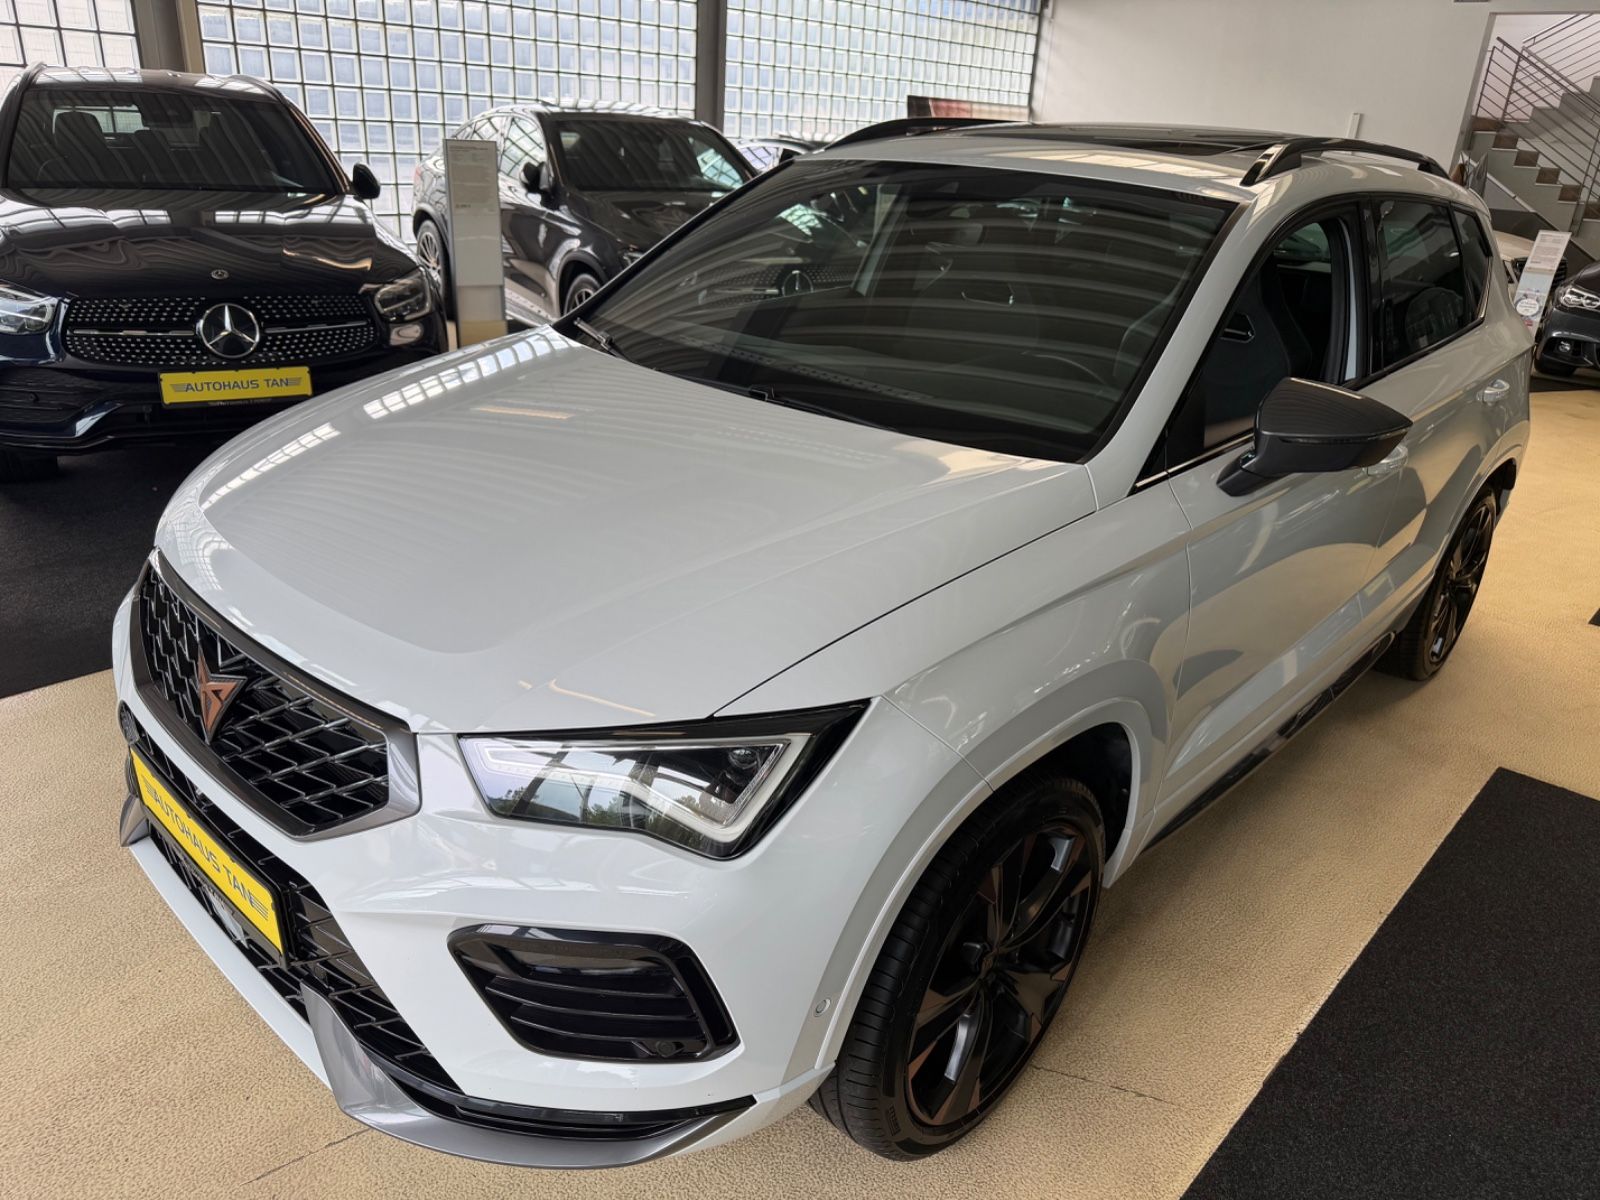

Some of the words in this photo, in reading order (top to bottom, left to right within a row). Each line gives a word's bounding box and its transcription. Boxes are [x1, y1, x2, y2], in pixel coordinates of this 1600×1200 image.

[185, 379, 259, 392] AUTOHAUS
[264, 377, 289, 387] TAN
[154, 793, 221, 873] AUTOHAUS
[223, 865, 254, 905] TAN
